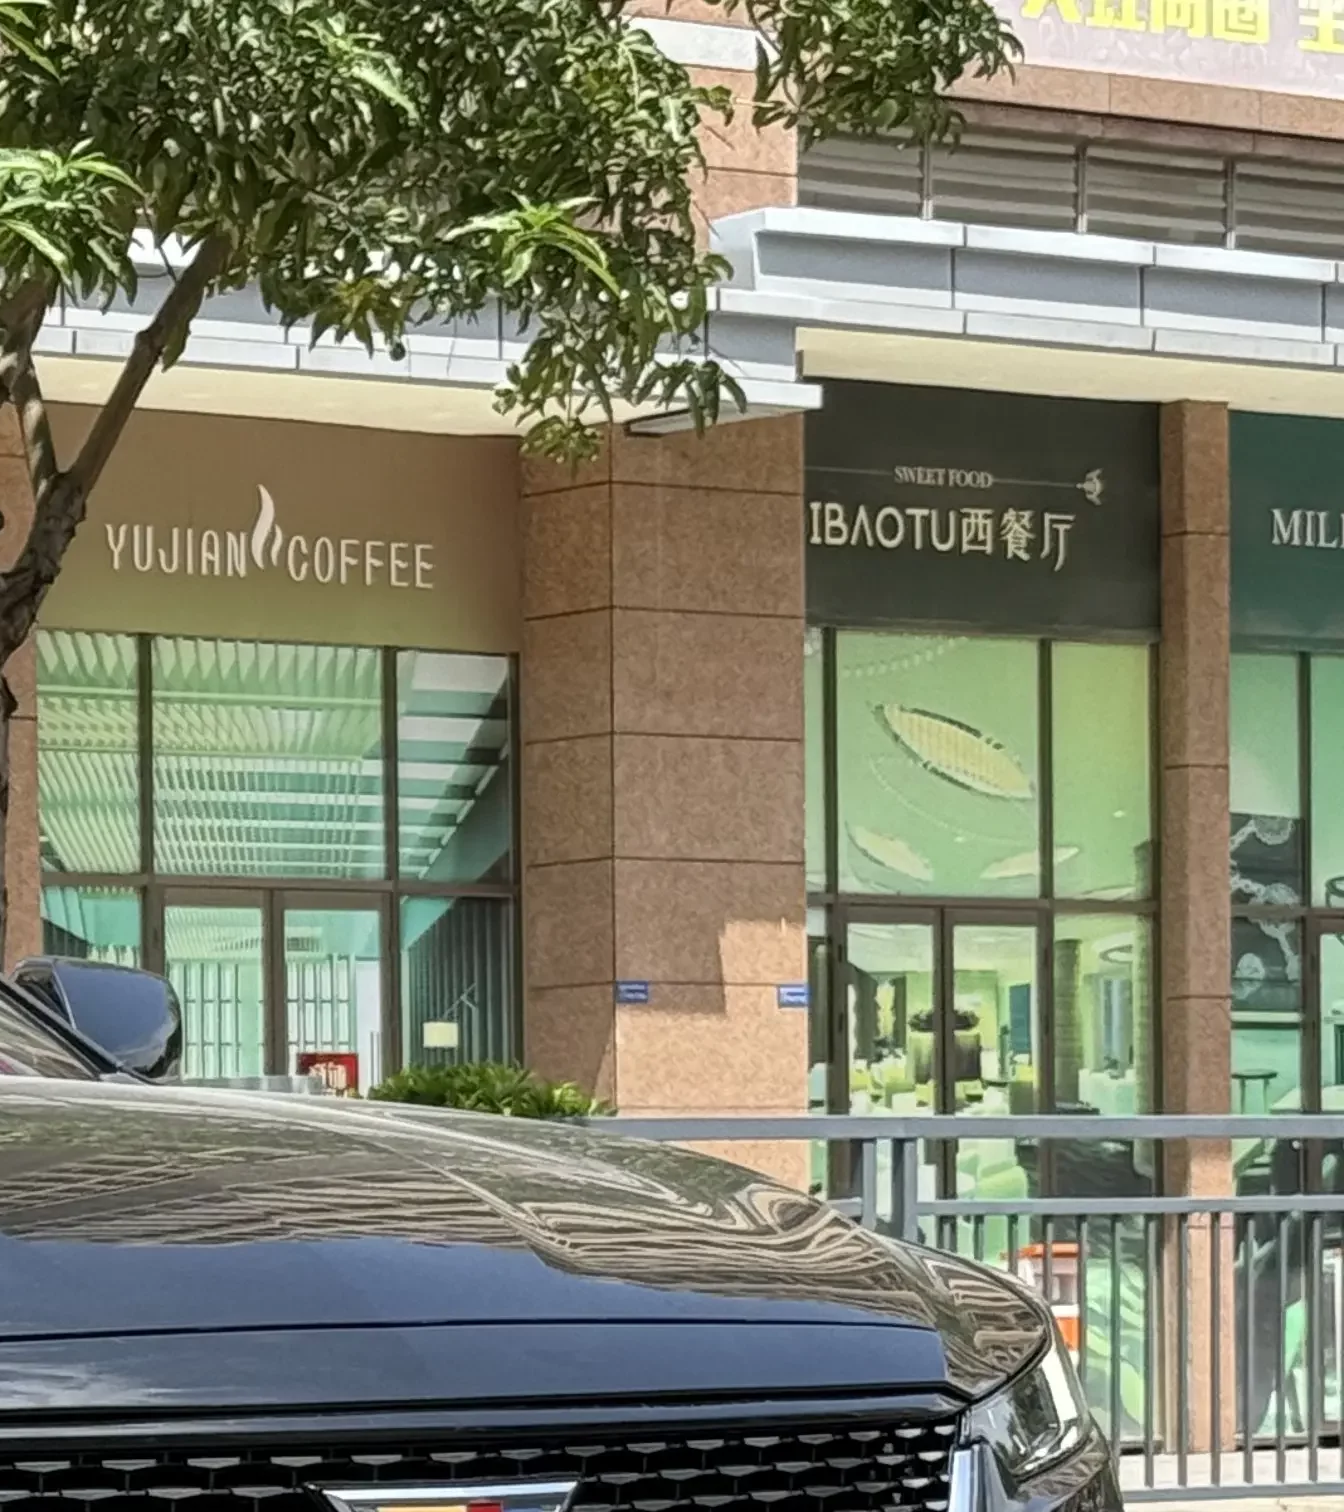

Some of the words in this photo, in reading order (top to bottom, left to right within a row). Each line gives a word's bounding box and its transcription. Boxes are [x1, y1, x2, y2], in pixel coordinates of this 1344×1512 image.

[894, 465, 946, 486] SWEET
[948, 468, 993, 488] FOOD
[1270, 507, 1344, 549] MIL
[105, 523, 248, 578] YUJIAN
[287, 534, 435, 589] COFFEE
